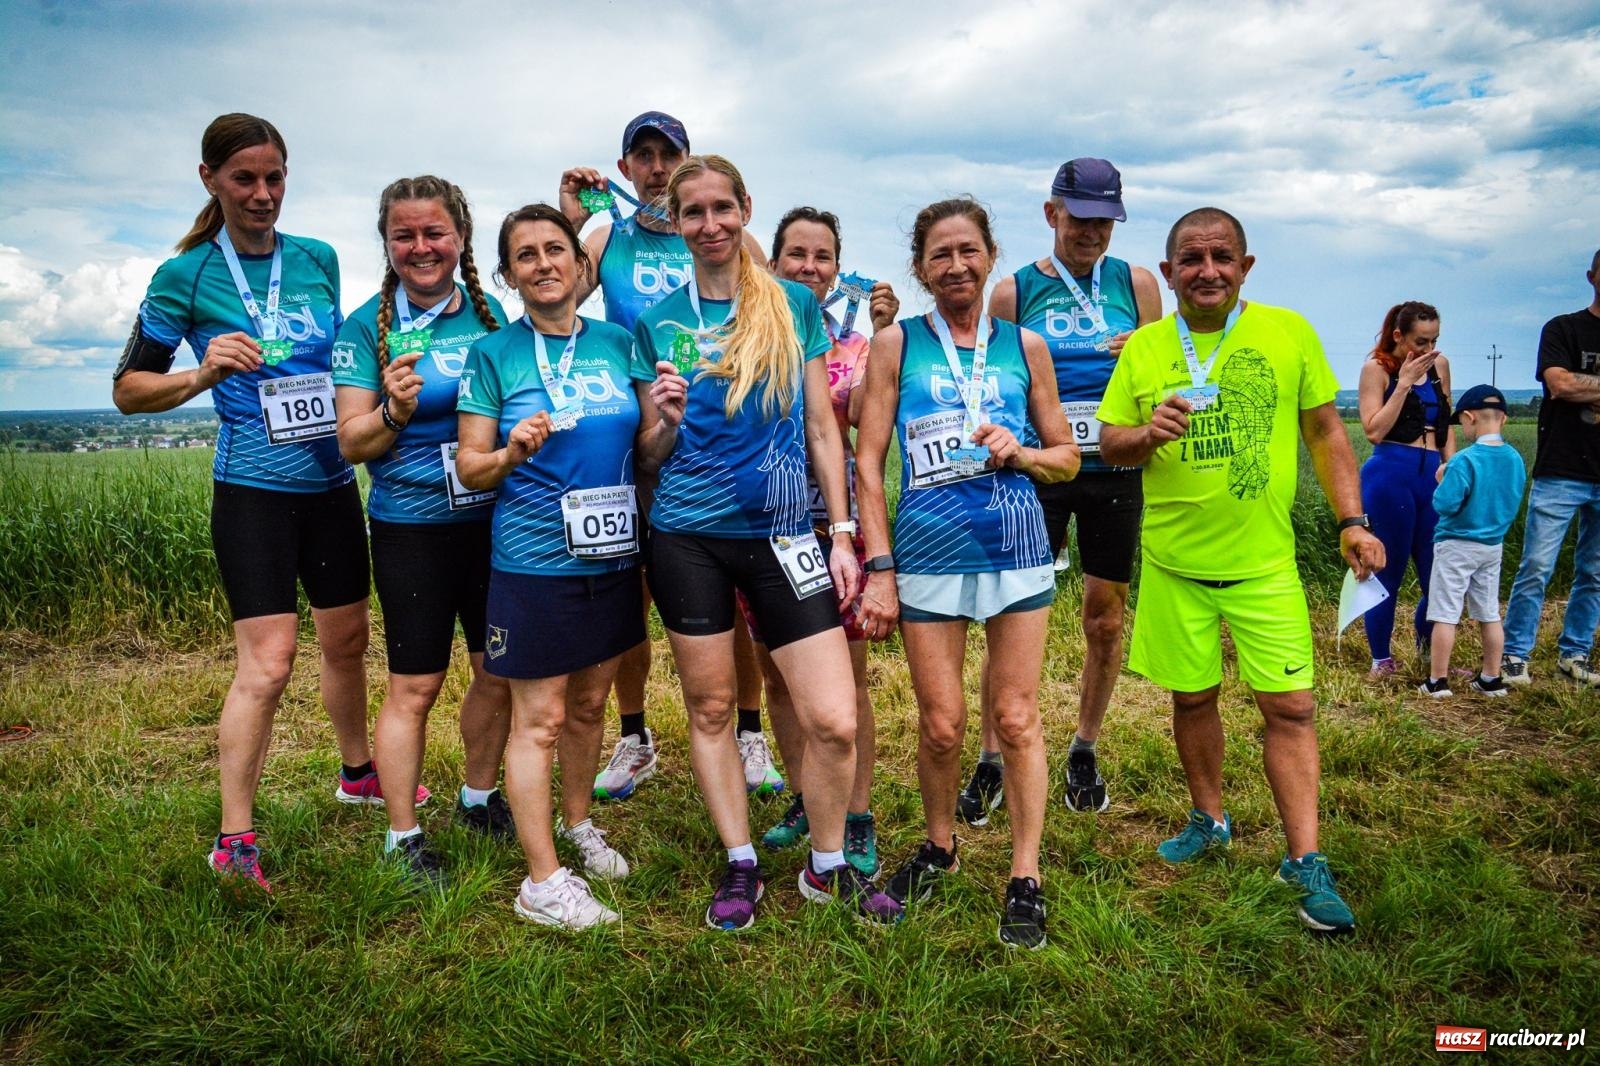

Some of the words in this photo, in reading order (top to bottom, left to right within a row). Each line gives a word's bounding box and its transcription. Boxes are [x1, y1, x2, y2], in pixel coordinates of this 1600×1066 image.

[635, 250, 694, 260] BiegamBoLubi
[296, 379, 306, 387] NA
[281, 396, 325, 423] 180
[585, 406, 620, 416] CIBÓRZ
[1180, 442, 1188, 462] Z
[1193, 435, 1235, 461] NAMI
[583, 511, 629, 539] 052
